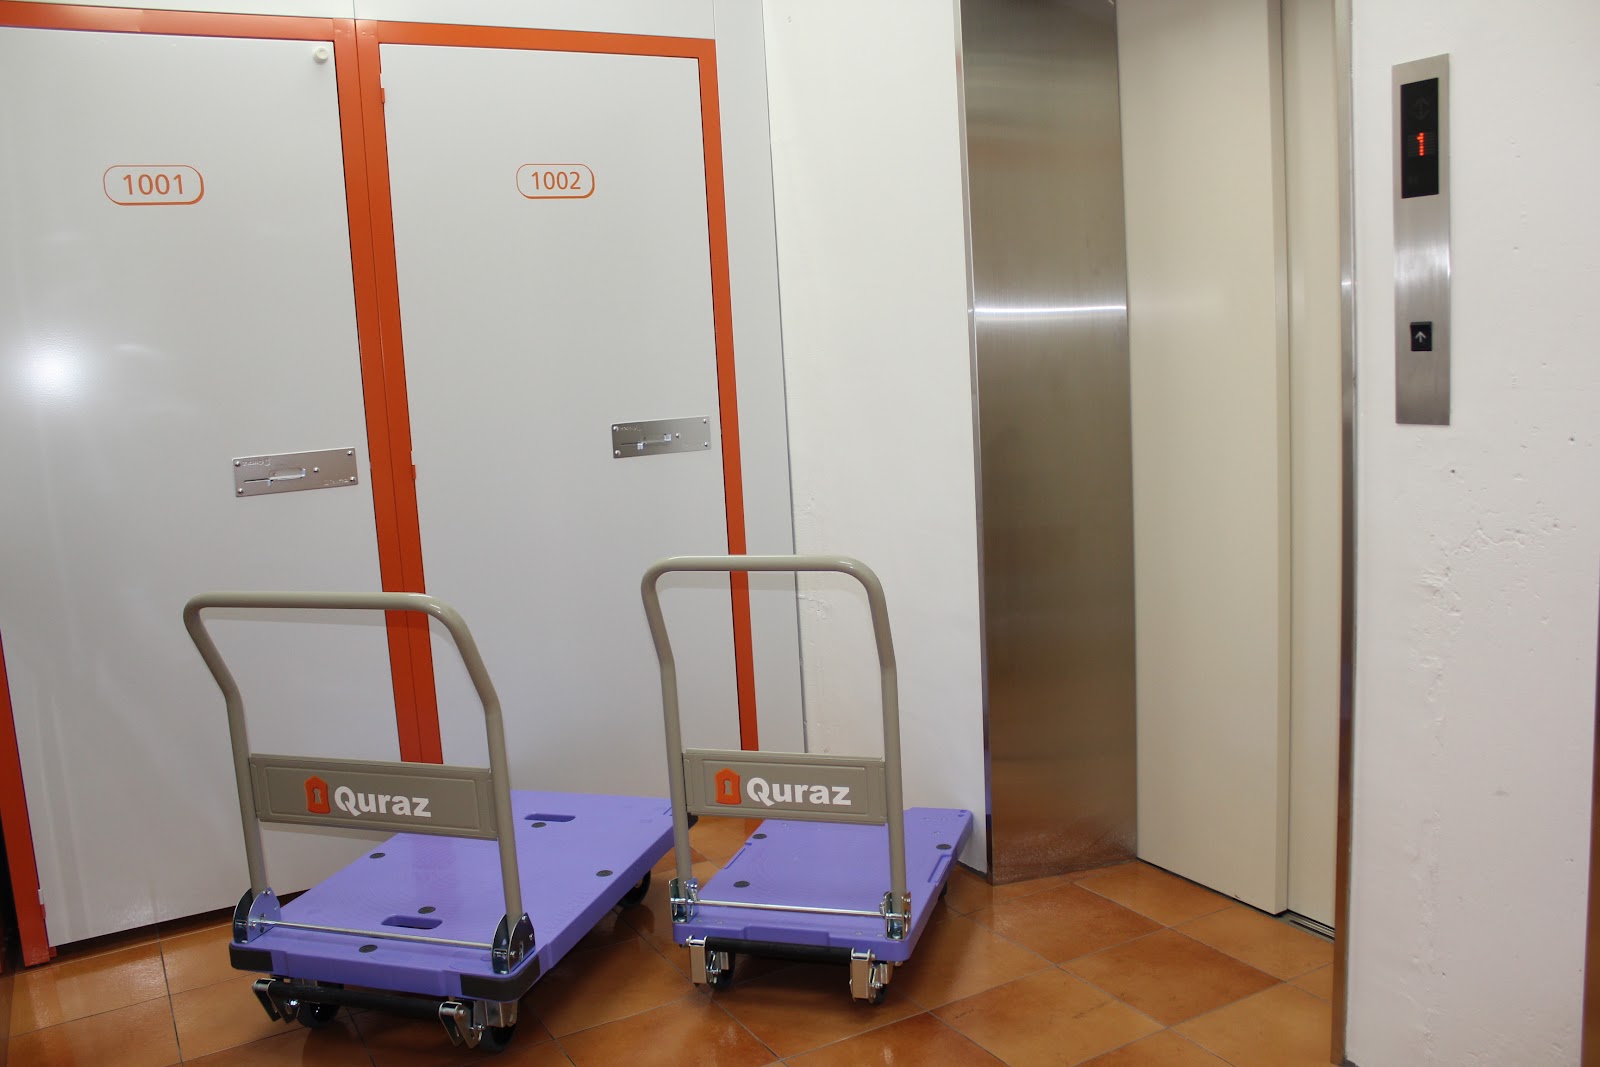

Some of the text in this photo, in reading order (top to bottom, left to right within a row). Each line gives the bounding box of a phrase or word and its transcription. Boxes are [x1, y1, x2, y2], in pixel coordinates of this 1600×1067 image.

[1416, 132, 1425, 156] 1
[123, 173, 183, 195] 1001
[531, 171, 581, 190] 1002
[334, 786, 432, 817] Quraz
[746, 777, 852, 807] Quraz
